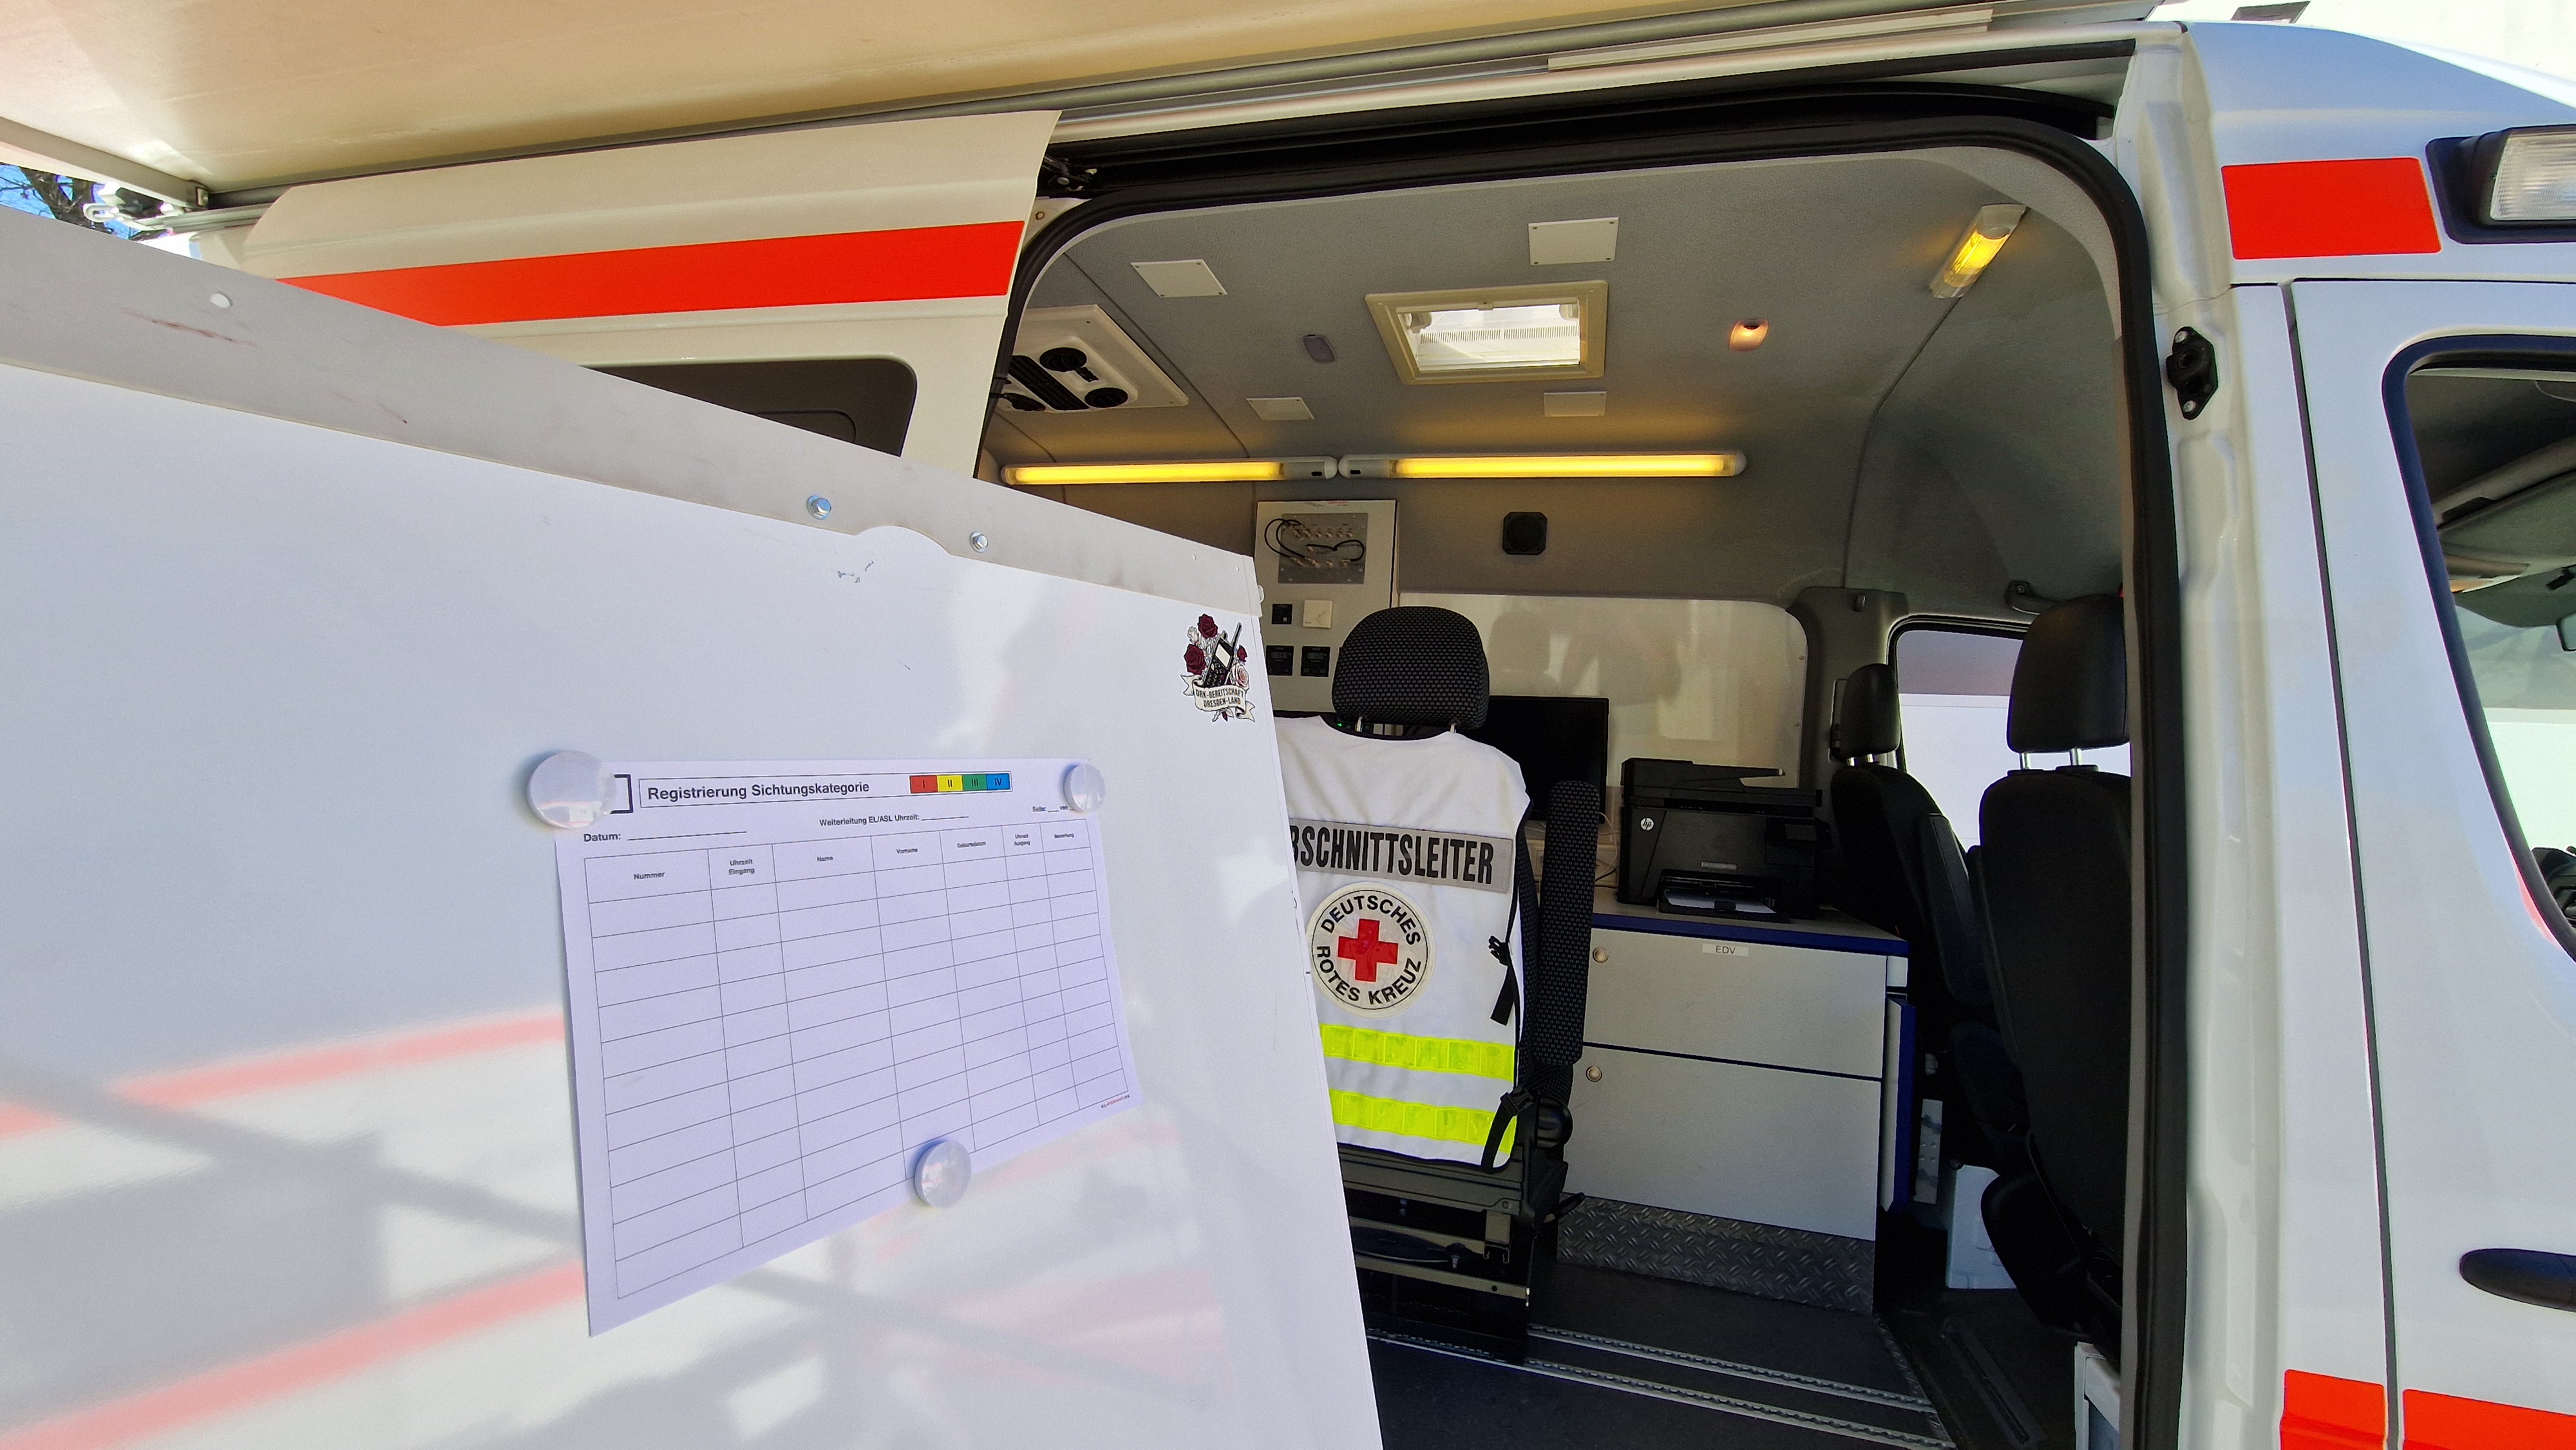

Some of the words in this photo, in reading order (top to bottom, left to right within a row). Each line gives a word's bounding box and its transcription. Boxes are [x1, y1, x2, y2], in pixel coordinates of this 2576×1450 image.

[1204, 697, 1241, 708] DRESDEN-LAND
[648, 786, 746, 802] Registrierung
[752, 782, 869, 796] Sichtungskategorie
[994, 777, 1003, 786] IV
[820, 816, 867, 827] Weiterleitung
[868, 815, 893, 824] EL/ASL
[895, 813, 920, 822] Uhrzeit:
[1642, 818, 1653, 830] hp
[583, 832, 621, 842] Datum:
[634, 871, 665, 881] Nummer
[728, 867, 755, 876] Eingang
[1321, 896, 1421, 945] DEUTSCHES
[1716, 945, 1736, 954] EDV
[1316, 946, 1360, 1002] ROTES
[1368, 958, 1421, 1005] KREUZ
